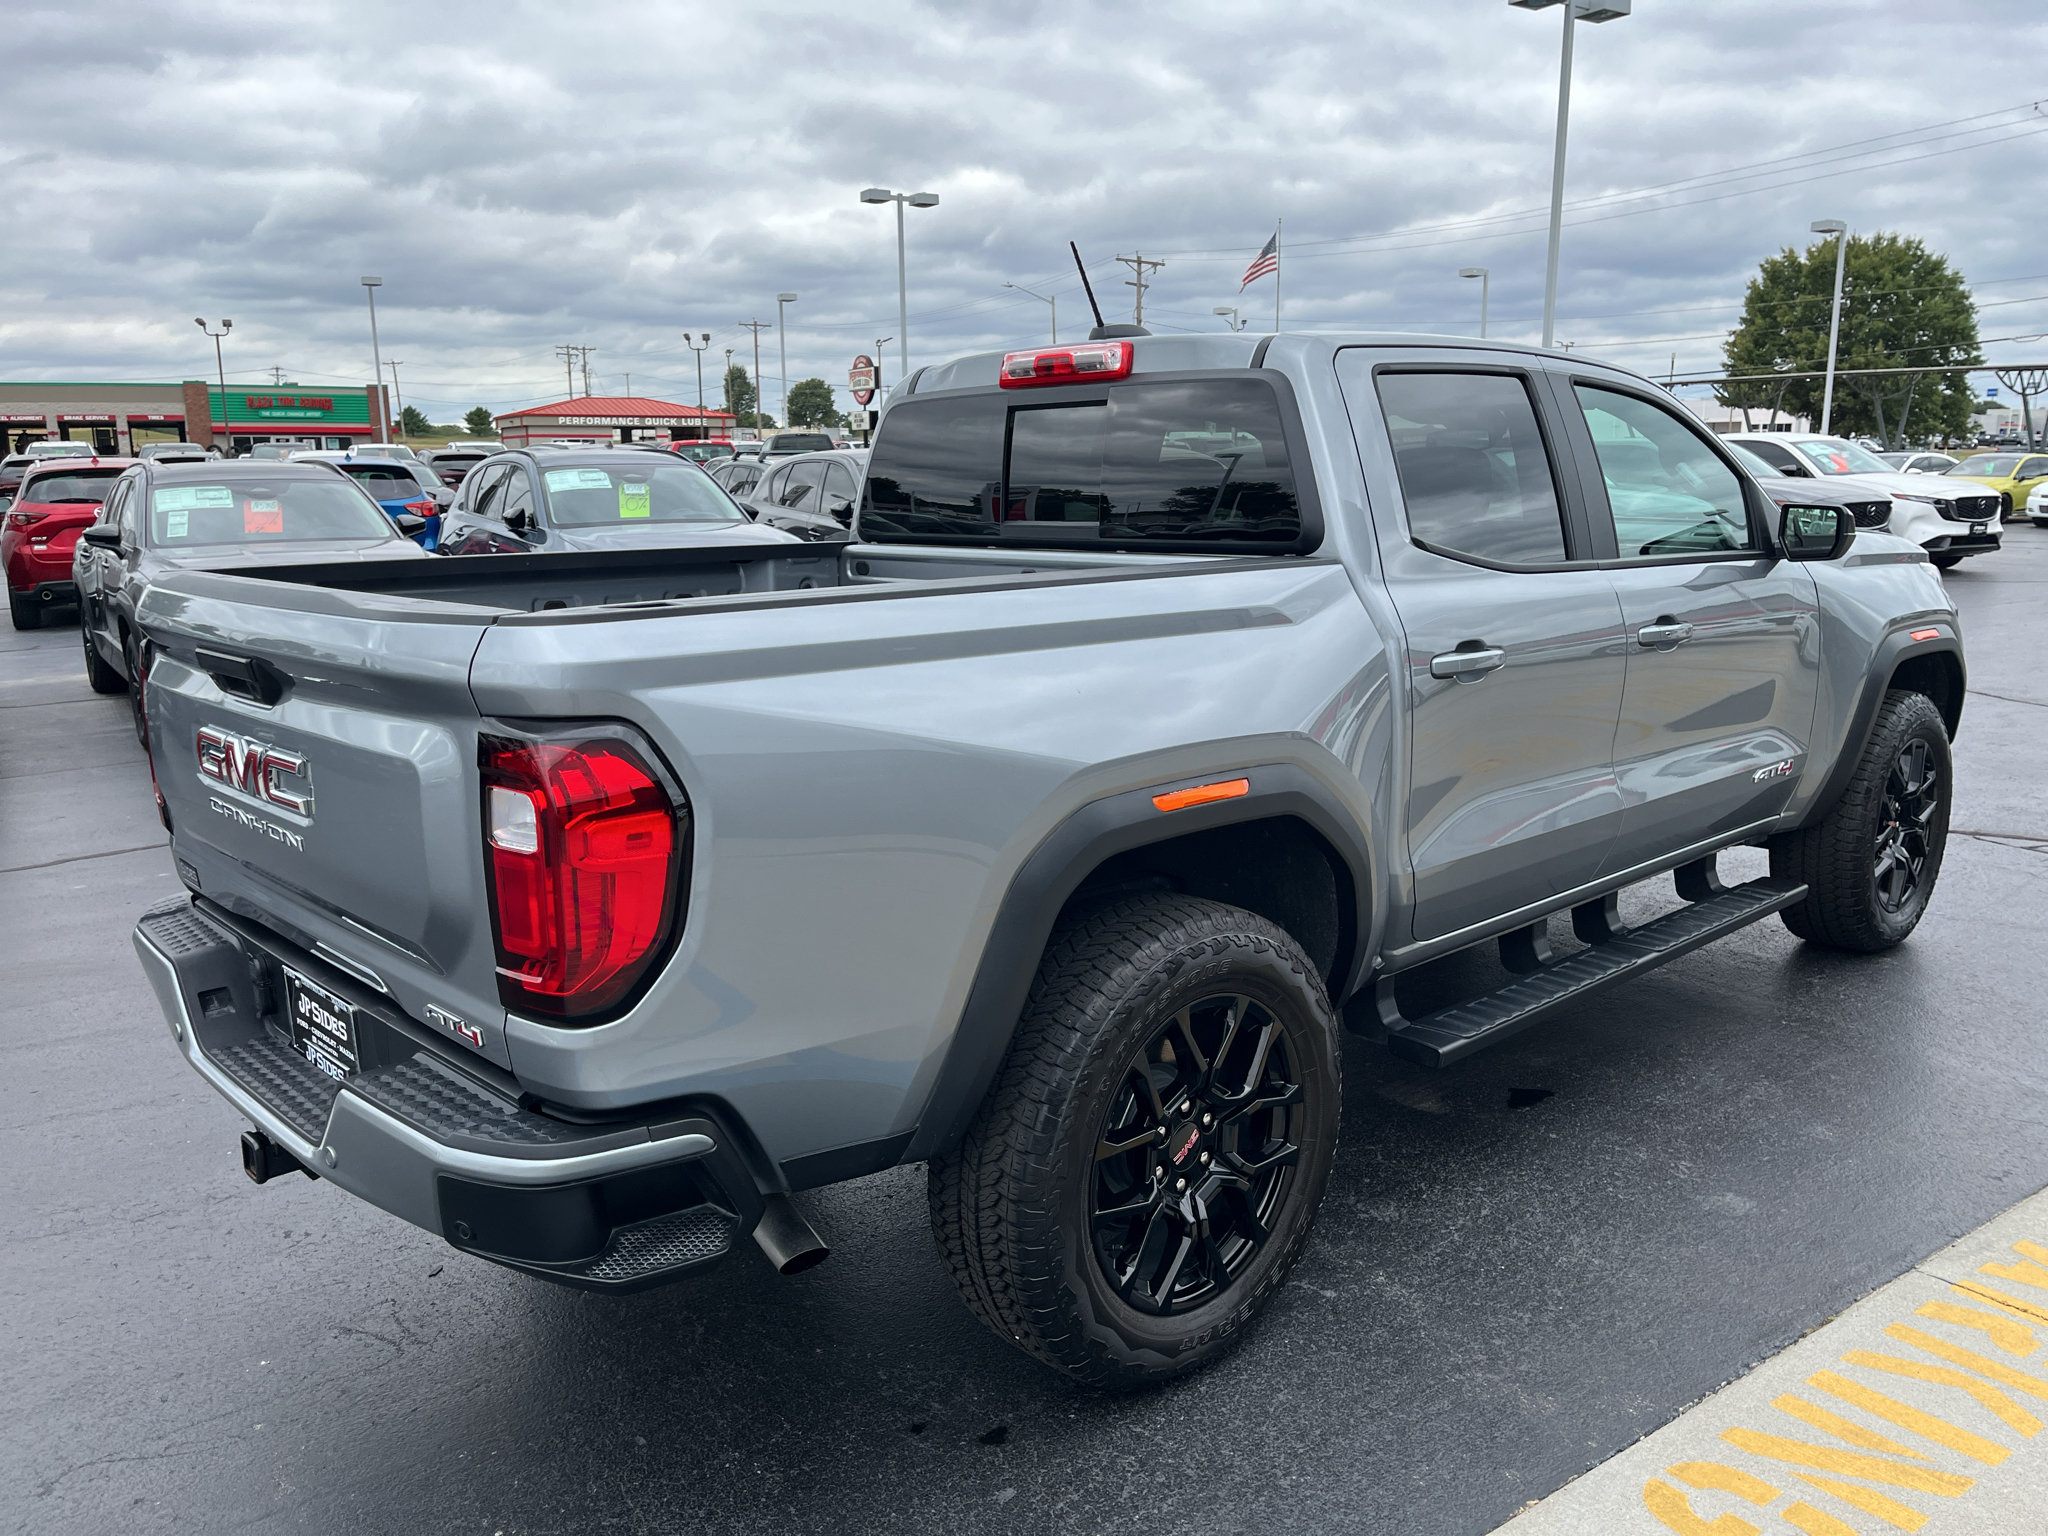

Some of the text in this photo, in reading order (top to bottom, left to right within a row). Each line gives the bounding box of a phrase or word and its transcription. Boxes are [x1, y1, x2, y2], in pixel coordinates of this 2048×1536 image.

[246, 396, 334, 411] PLAZA TIRE SERVICE
[558, 416, 708, 427] PERFORMANCE QUICK LUBE
[197, 724, 315, 820] GMC
[1751, 758, 1795, 784] AT4
[208, 796, 305, 853] CANYON
[298, 992, 348, 1042] JP SIDES
[422, 1002, 486, 1049] AT4
[316, 1053, 346, 1082] SIDES
[1172, 1128, 1200, 1166] GMC
